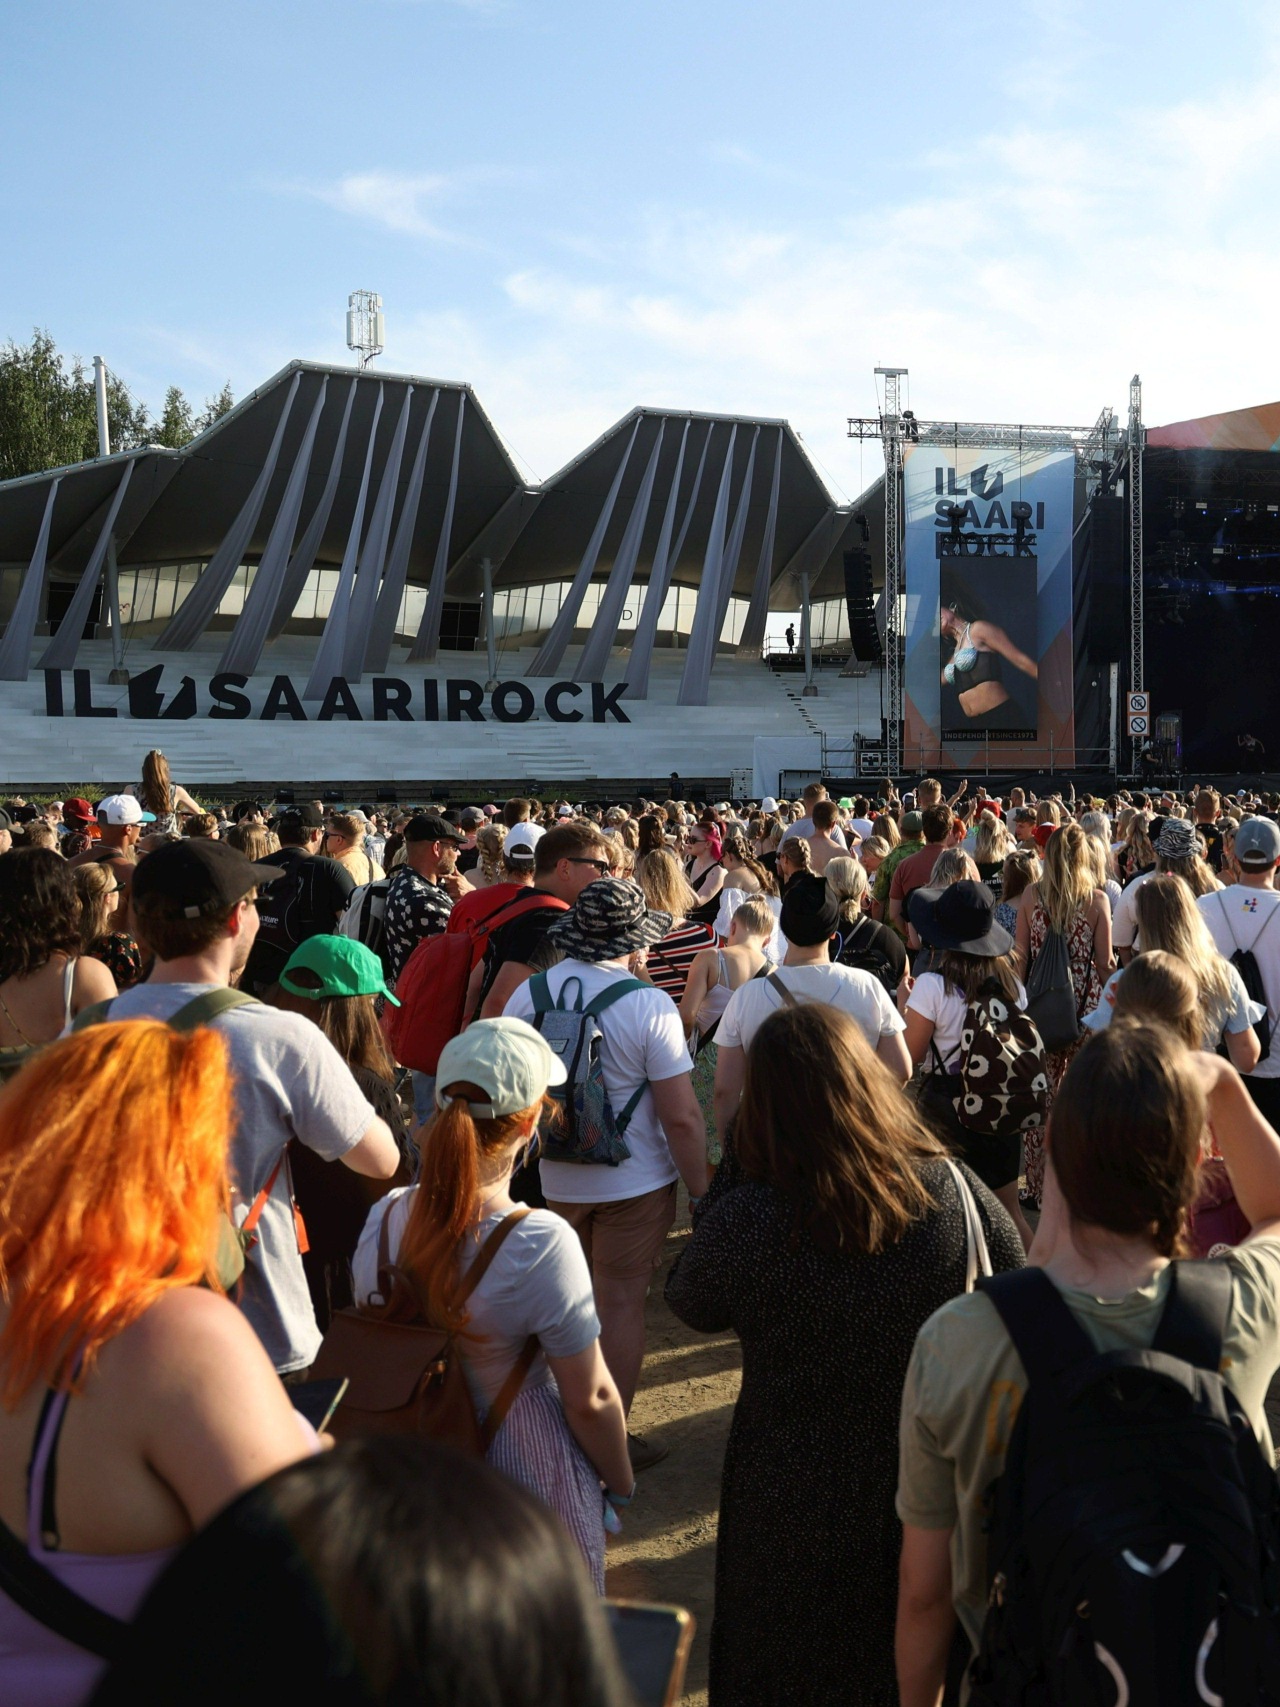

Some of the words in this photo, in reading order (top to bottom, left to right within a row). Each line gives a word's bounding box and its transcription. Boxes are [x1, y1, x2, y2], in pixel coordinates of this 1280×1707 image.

[934, 499, 1044, 529] SAARI
[935, 532, 1036, 559] ROCK
[622, 609, 633, 621] D
[87, 807, 93, 816] S
